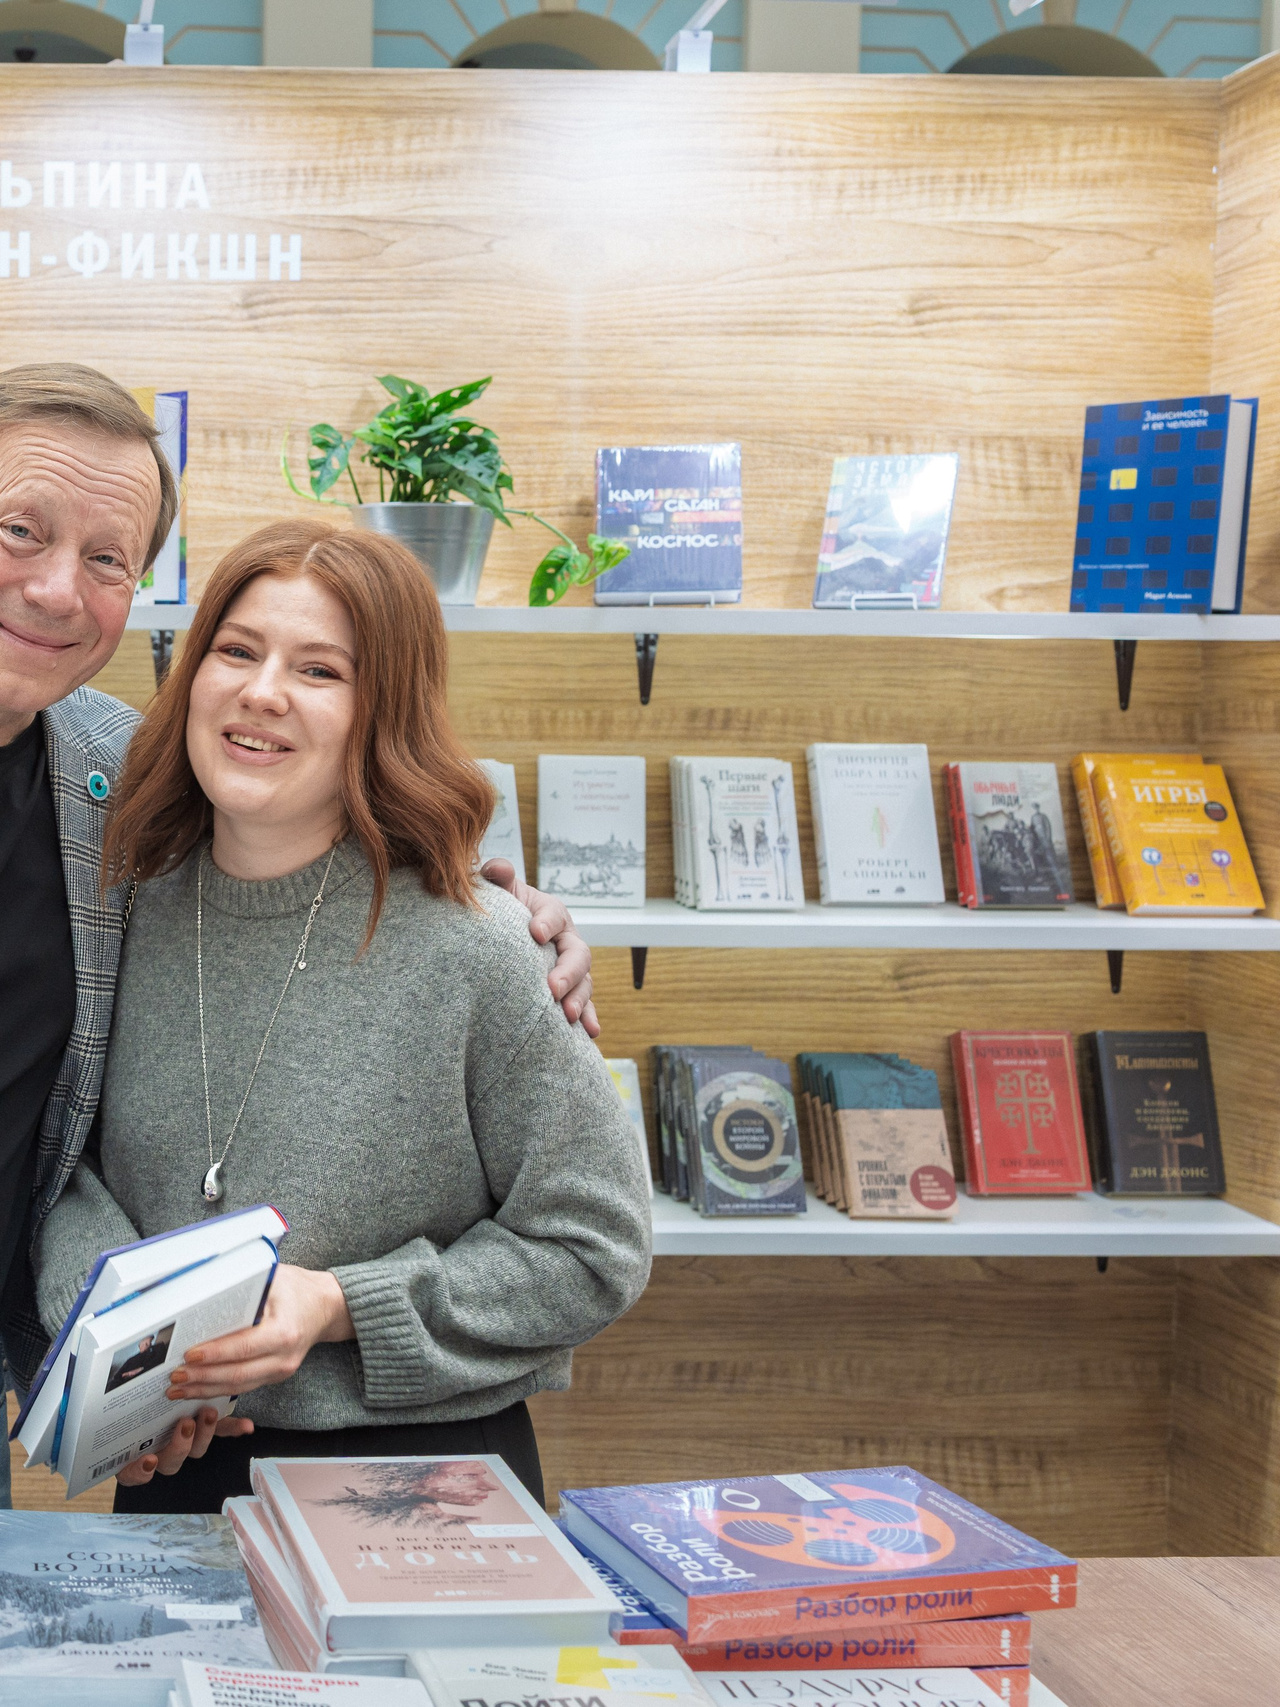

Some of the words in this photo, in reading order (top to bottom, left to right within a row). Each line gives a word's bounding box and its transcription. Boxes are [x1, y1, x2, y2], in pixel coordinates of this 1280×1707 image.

[1144, 408, 1209, 423] Зависимость
[1166, 418, 1208, 430] человек
[608, 487, 655, 503] КАРЛ
[664, 497, 720, 513] САГАН
[637, 533, 720, 549] КОСМОС
[1131, 784, 1209, 804] ИГРЫ
[1130, 1166, 1158, 1179] ДЭН
[66, 1551, 167, 1563] СОВЫ
[357, 1543, 517, 1553] Нелюбимая
[630, 1522, 719, 1583] Разбор
[354, 1550, 539, 1571] ДОЧЬ
[681, 1537, 757, 1580] роли
[32, 1562, 78, 1573] ВО
[91, 1562, 206, 1577] ЛЬДАХ
[795, 1592, 897, 1621] Разбор
[904, 1587, 974, 1616] роли
[724, 1636, 833, 1663] Разбор
[842, 1636, 917, 1662] роли
[204, 1667, 304, 1684] Создание
[310, 1678, 360, 1688] арки
[207, 1675, 320, 1694] персонажа
[209, 1681, 297, 1699] Секреты
[719, 1676, 952, 1700] ТЕЗАУРУС
